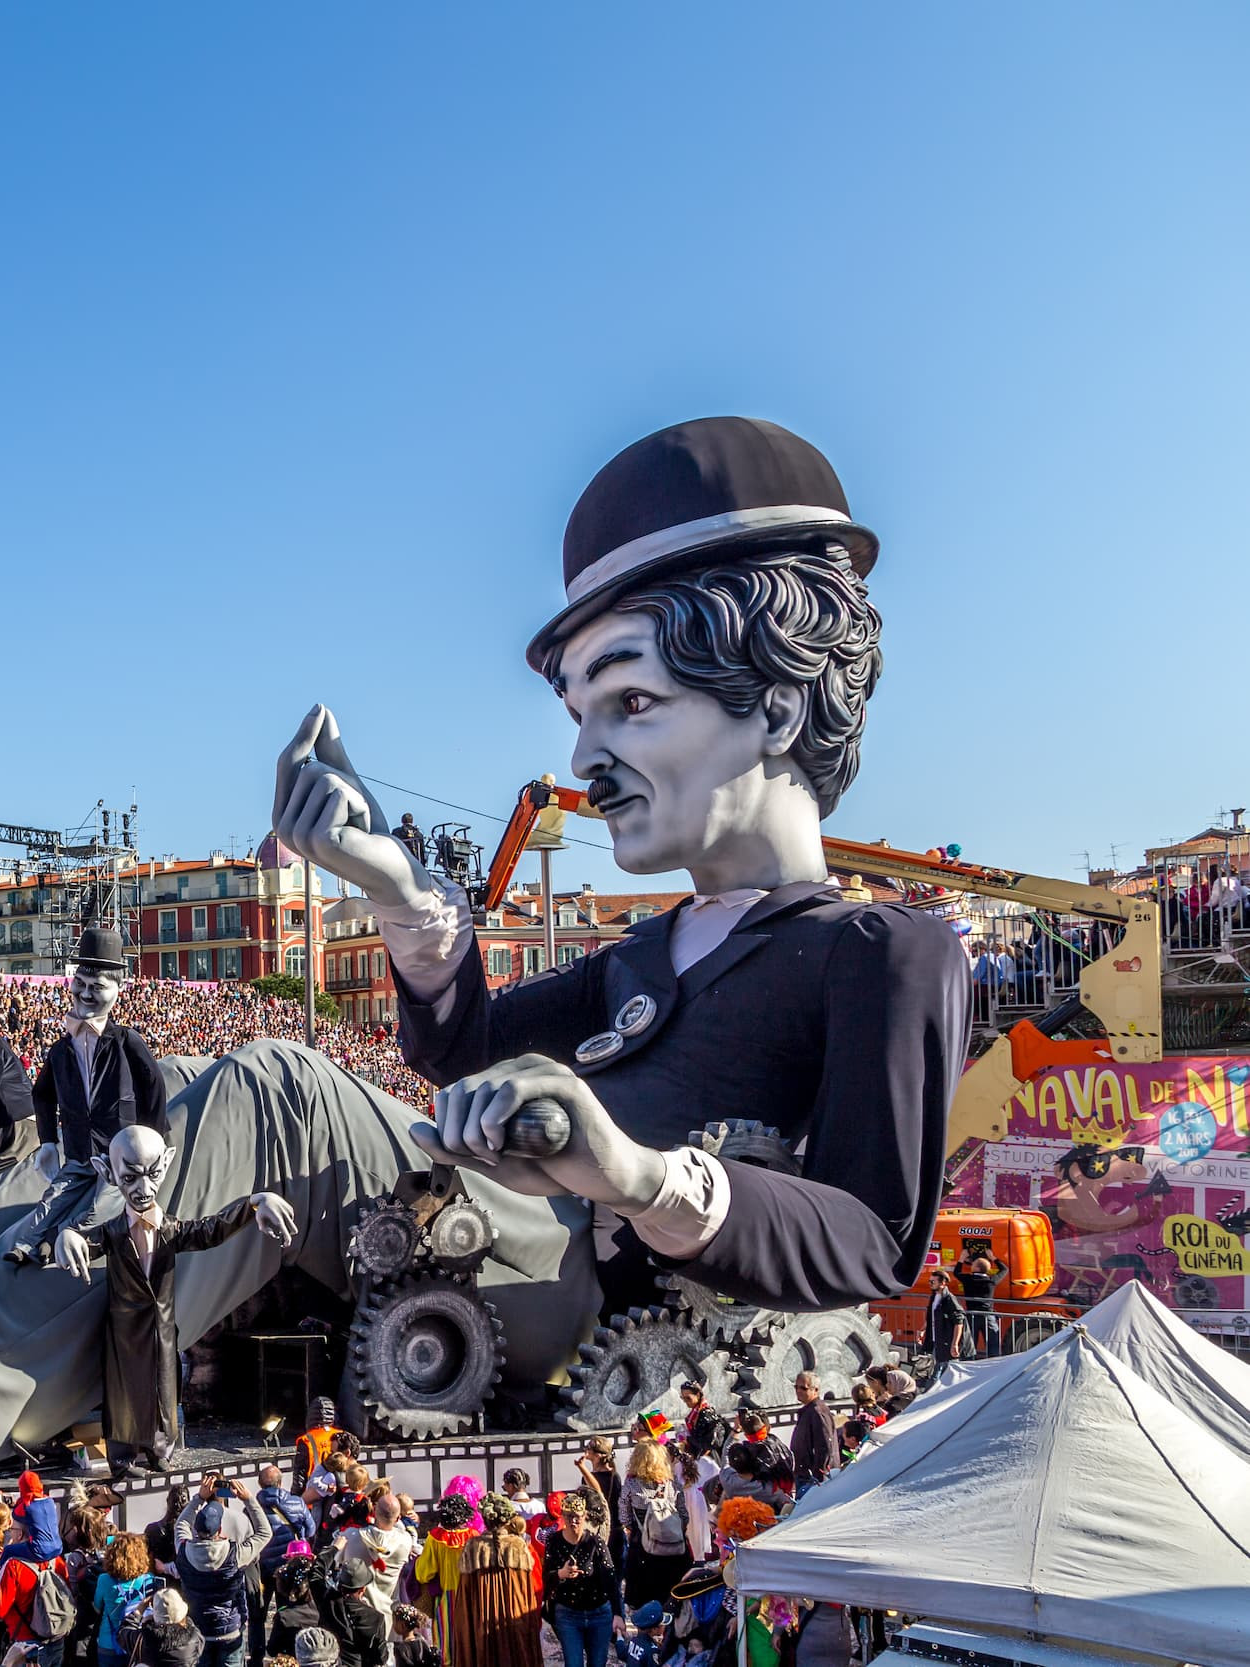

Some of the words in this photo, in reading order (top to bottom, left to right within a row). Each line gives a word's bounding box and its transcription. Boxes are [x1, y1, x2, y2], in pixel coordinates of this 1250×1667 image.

[1135, 914, 1151, 922] 26
[1150, 1081, 1175, 1104] DE
[1168, 1111, 1182, 1124] 16
[1164, 1132, 1173, 1145] 2
[1176, 1132, 1212, 1146] MARS
[1177, 1148, 1199, 1157] 2019
[1148, 1160, 1250, 1180] VICTORINE
[959, 1227, 993, 1236] 800AJ
[1171, 1222, 1209, 1248] ROI
[1215, 1236, 1231, 1249] DU
[1184, 1250, 1243, 1271] CINÉMA
